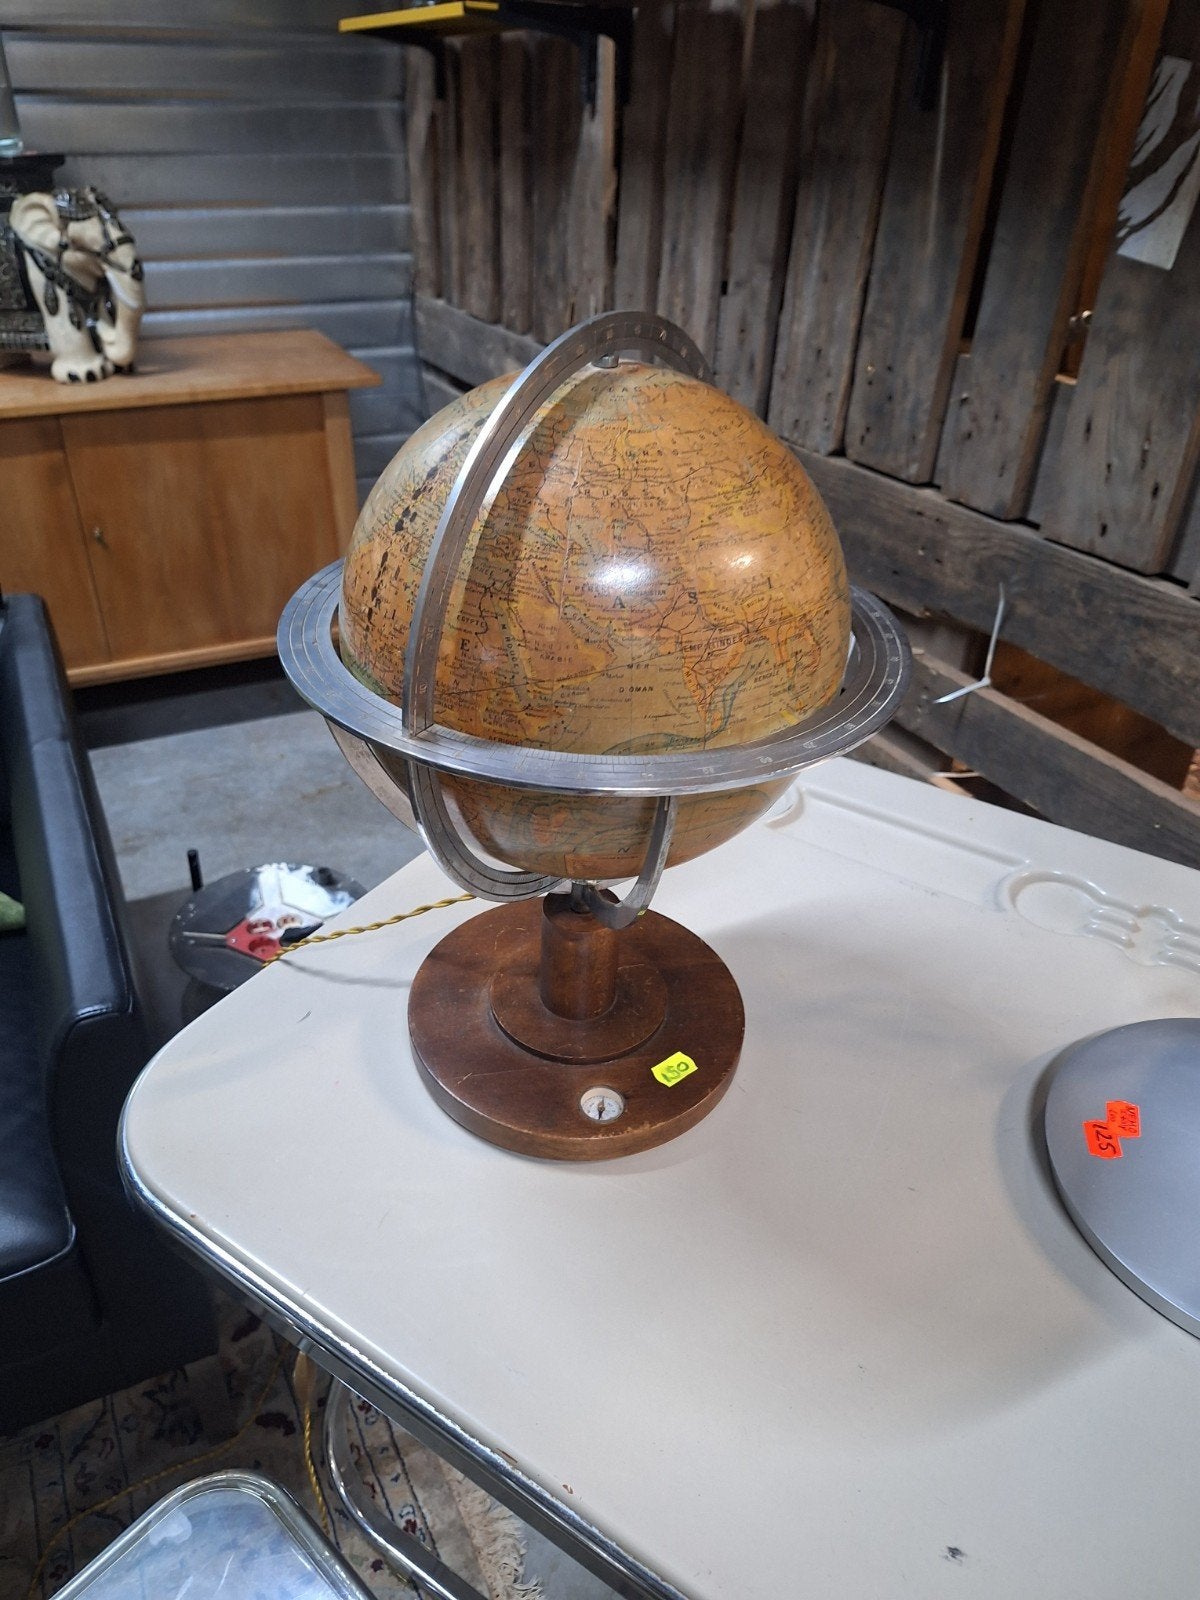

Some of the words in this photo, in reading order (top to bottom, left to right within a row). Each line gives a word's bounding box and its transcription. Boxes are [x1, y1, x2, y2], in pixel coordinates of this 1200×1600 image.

[628, 685, 655, 693] OMAN
[660, 1061, 690, 1083] 150
[1092, 1123, 1117, 1155] 125
